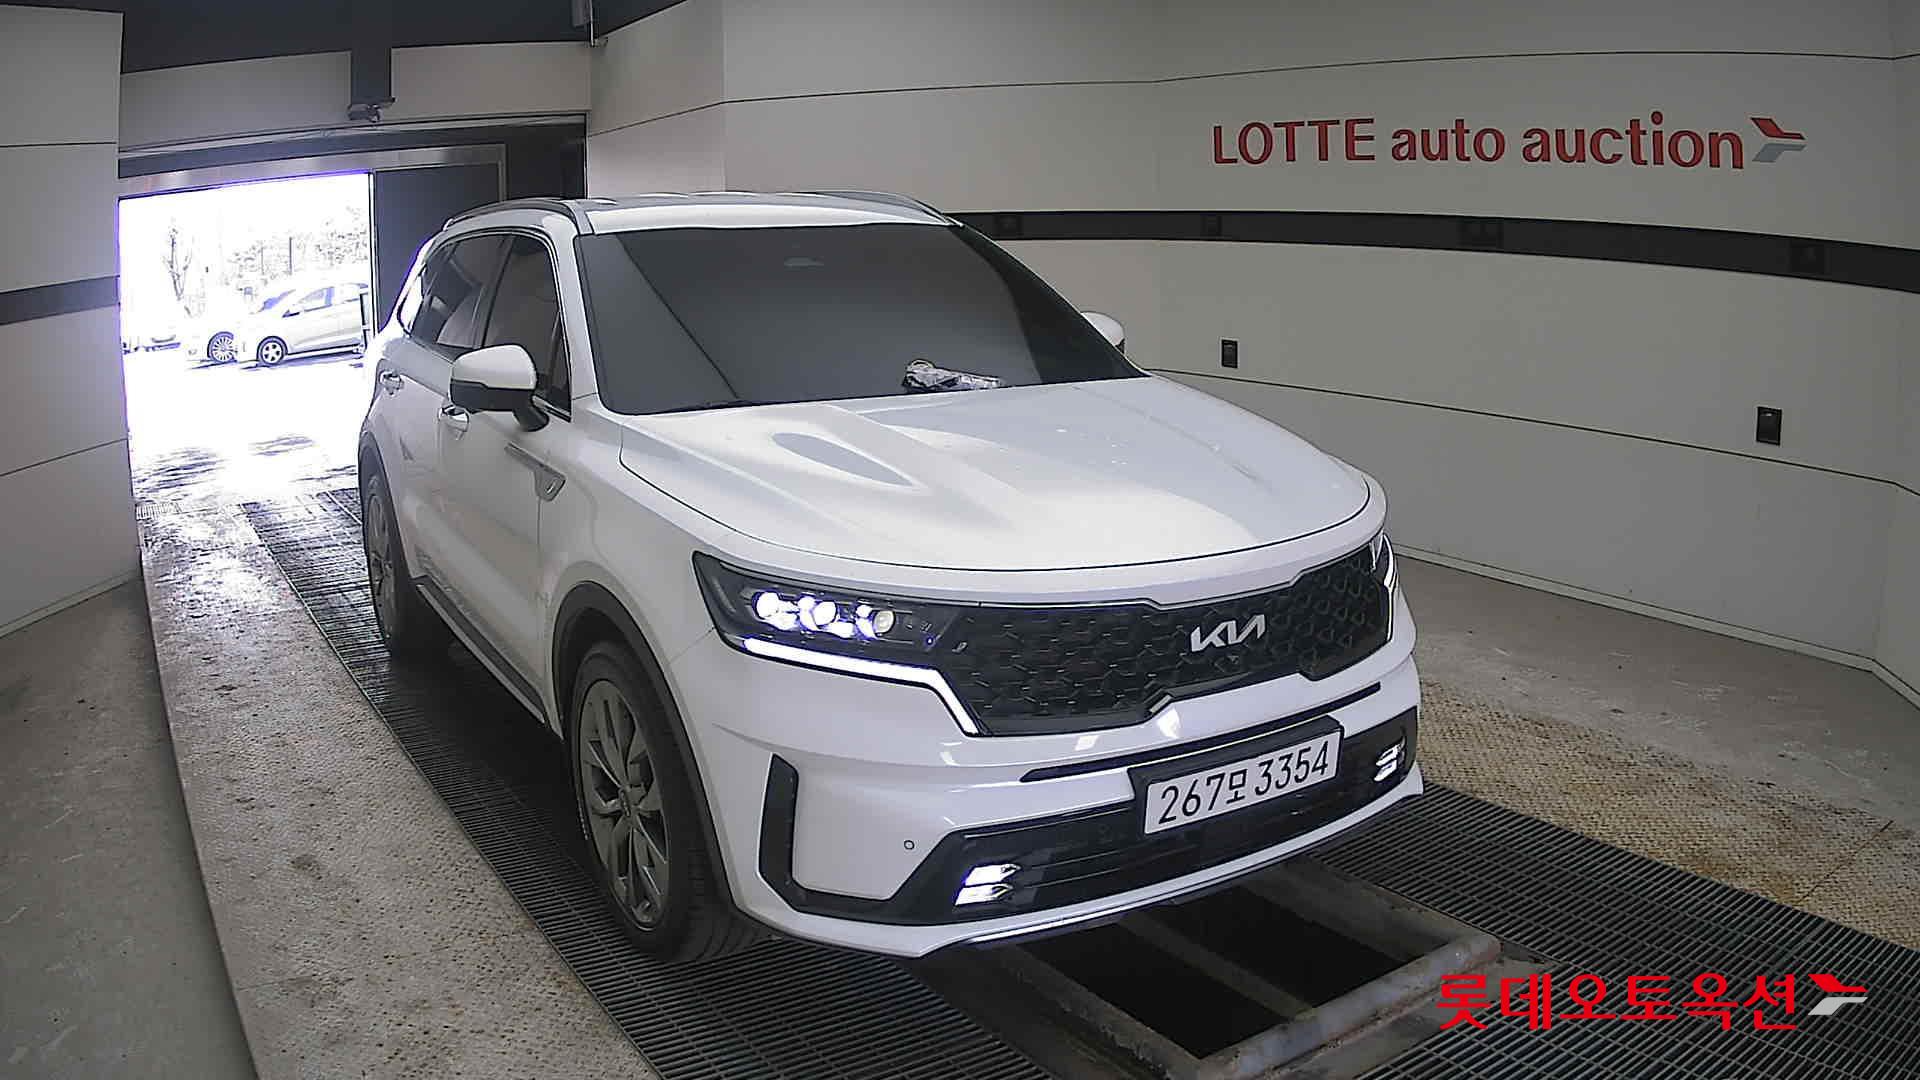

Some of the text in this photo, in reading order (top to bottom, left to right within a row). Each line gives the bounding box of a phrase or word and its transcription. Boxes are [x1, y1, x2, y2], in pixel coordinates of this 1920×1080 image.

[1213, 110, 1744, 169] LOTTE auto auction
[1190, 614, 1266, 652] KIA
[1158, 740, 1329, 825] 267모 3354
